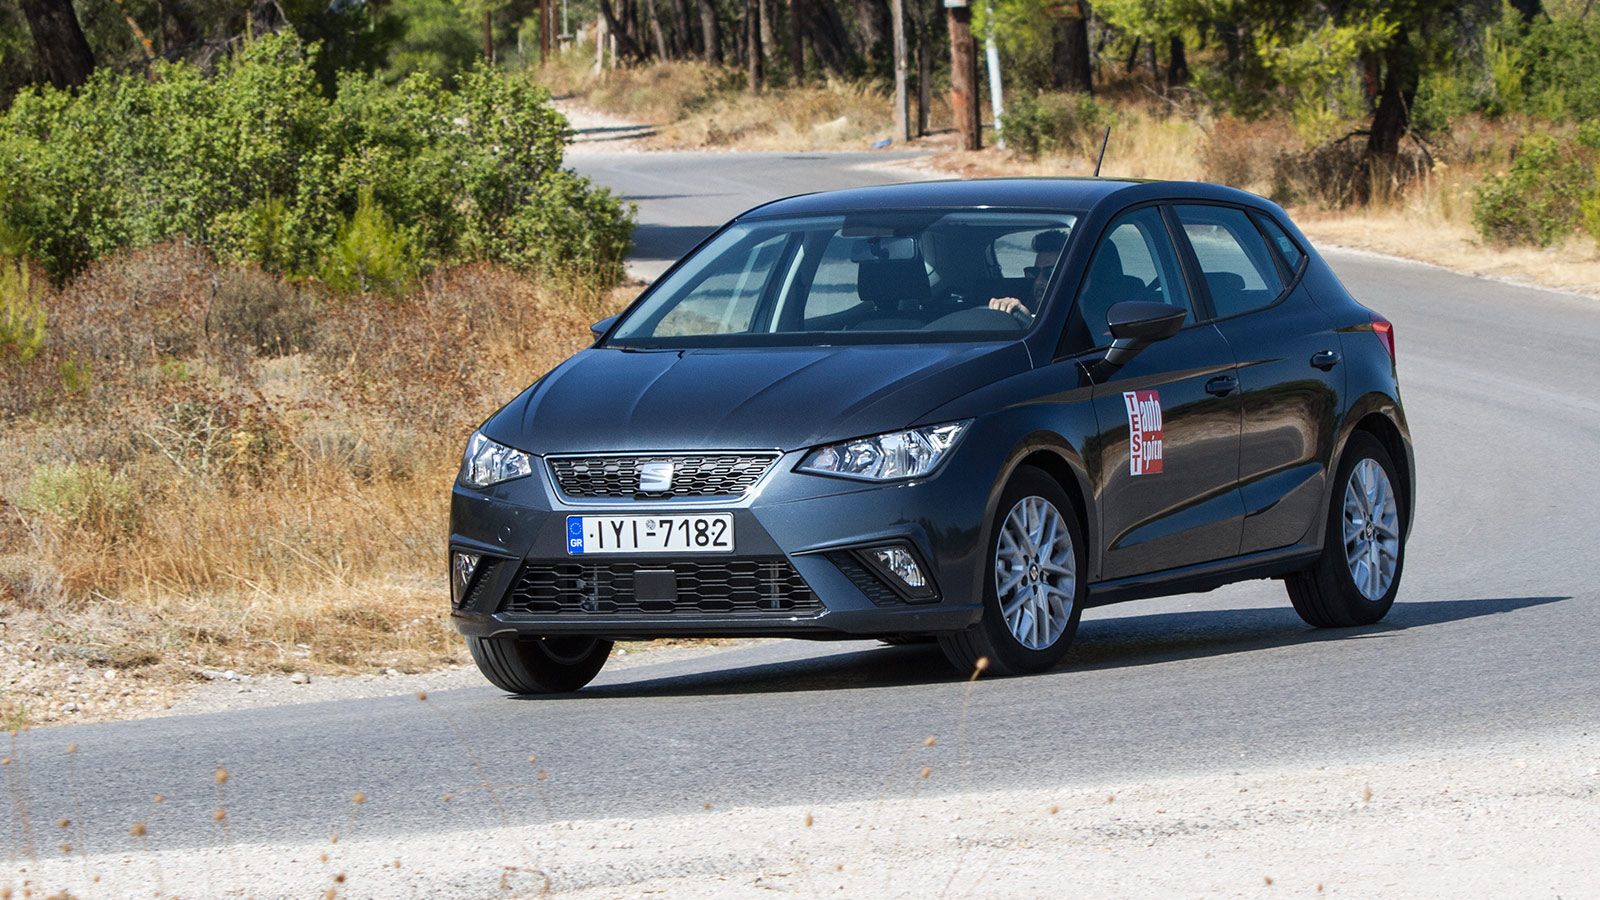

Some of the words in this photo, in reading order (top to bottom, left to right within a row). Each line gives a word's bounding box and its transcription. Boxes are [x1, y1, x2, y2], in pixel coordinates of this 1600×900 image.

[1139, 393, 1163, 432] auto
[1126, 394, 1141, 473] TEST
[570, 539, 583, 548] GR
